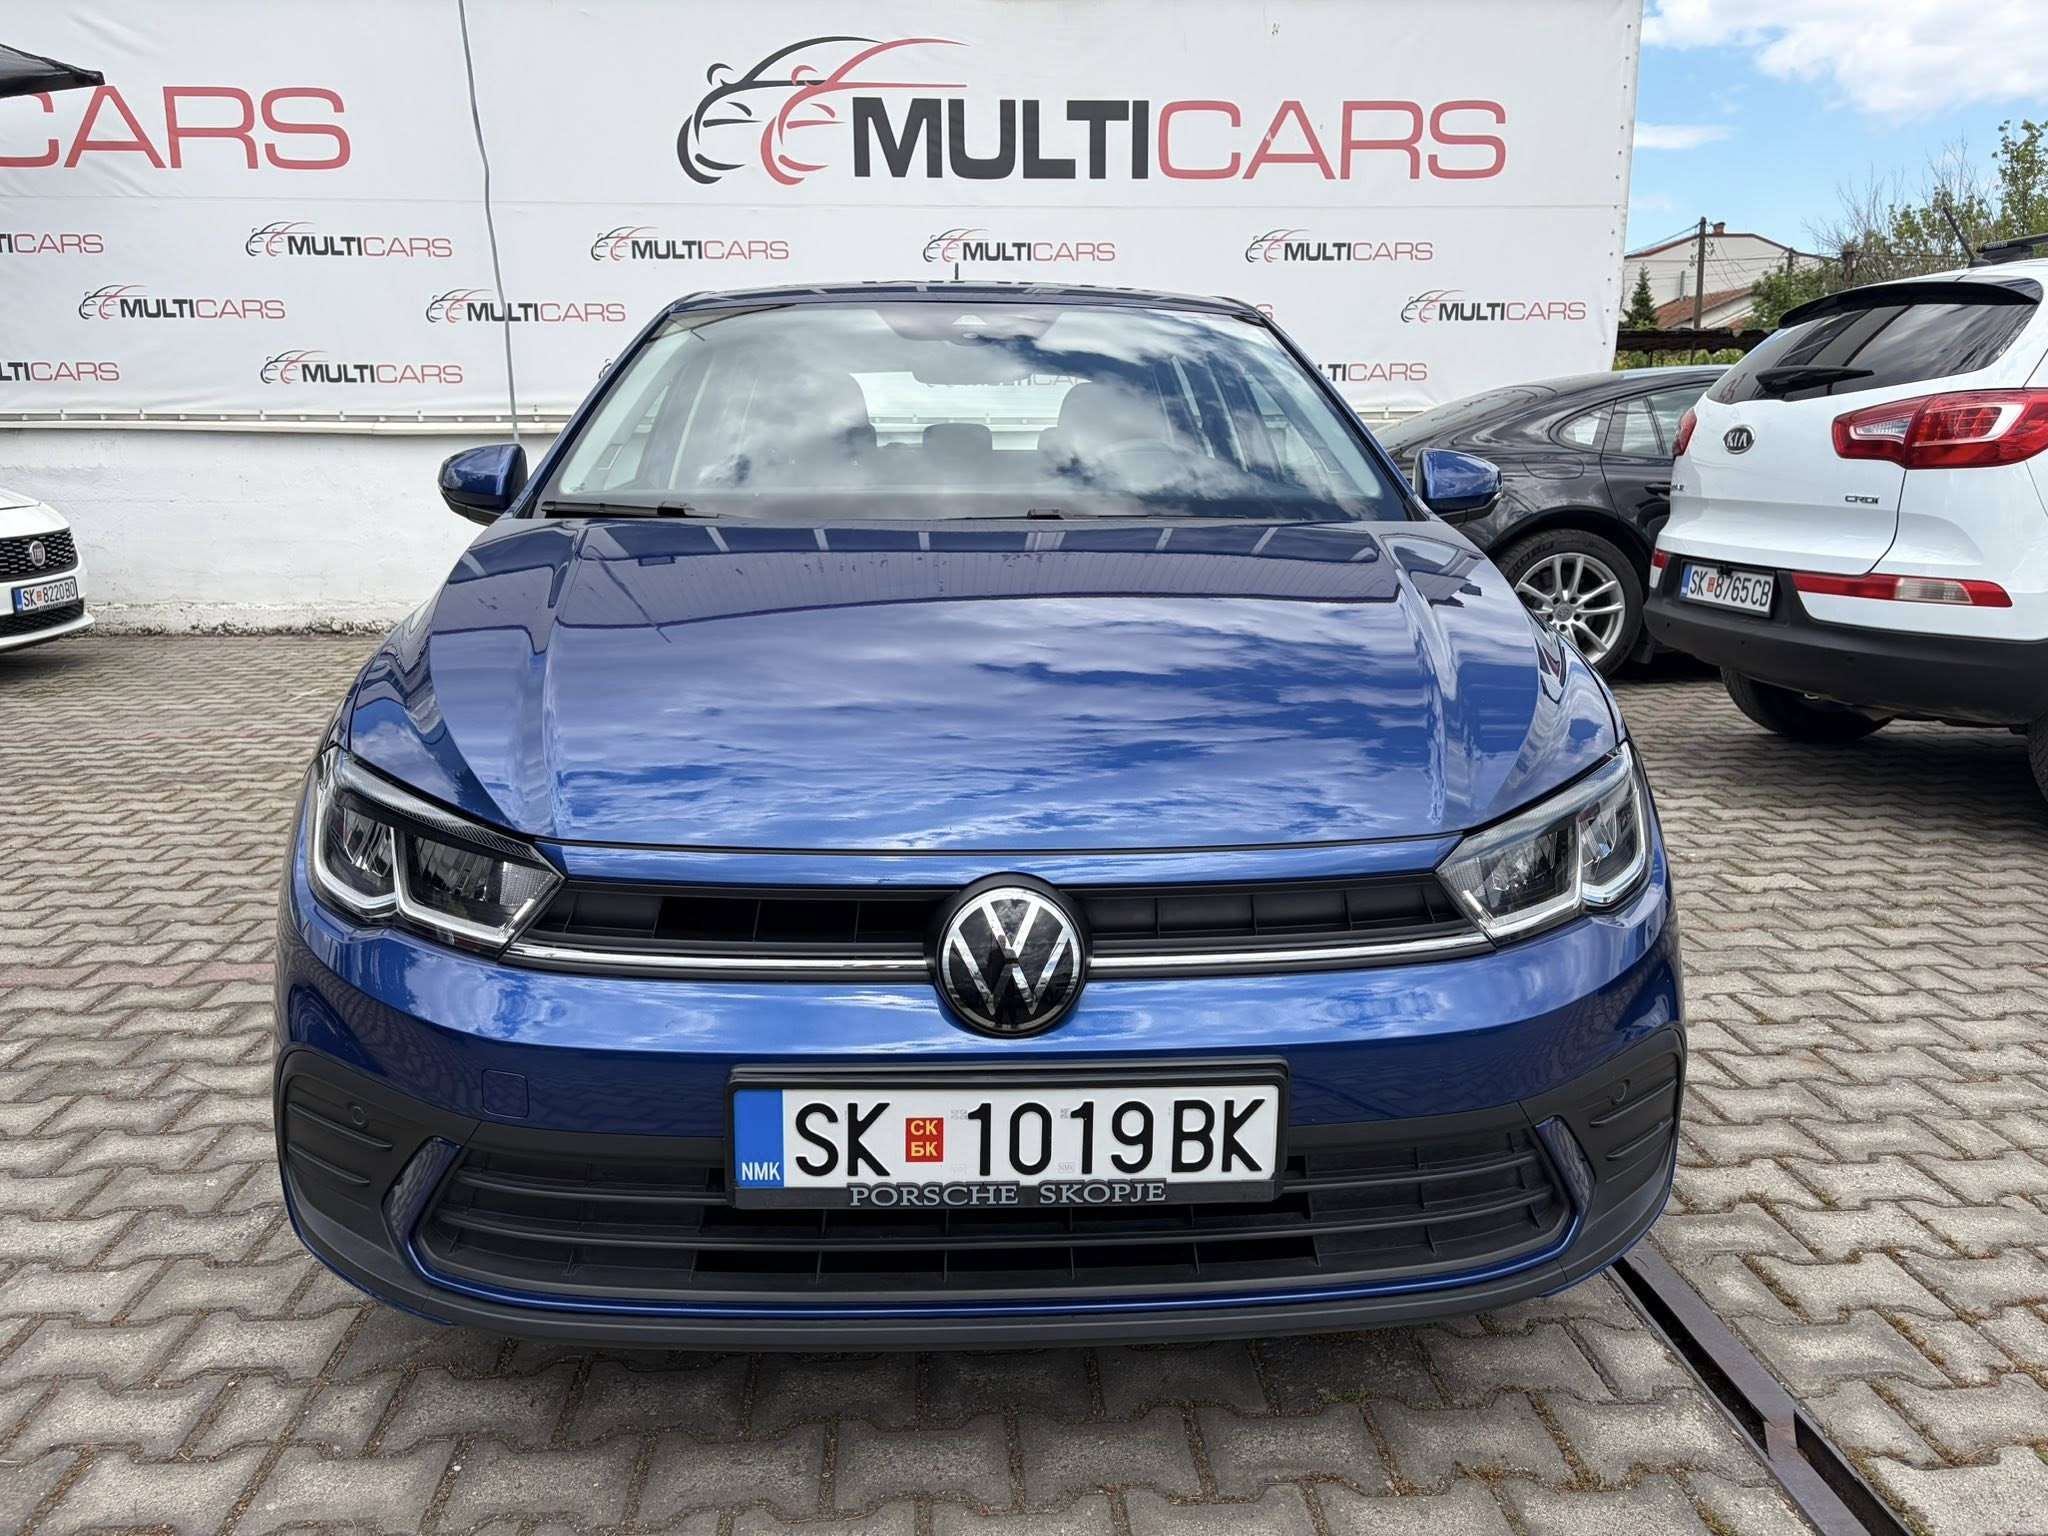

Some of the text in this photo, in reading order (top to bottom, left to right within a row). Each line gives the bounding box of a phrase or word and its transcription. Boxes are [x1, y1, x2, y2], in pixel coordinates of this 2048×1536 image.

[852, 96, 1506, 180] MULTICARS
[287, 235, 453, 258] MULTICARS
[631, 239, 789, 261] MULTICARS
[962, 241, 1116, 262] MULTICARS
[1283, 241, 1433, 262] MULTICARS
[119, 298, 286, 320] MULTICARS
[467, 302, 626, 322] MULTICARS
[1438, 301, 1586, 322] MULTICARS
[301, 363, 463, 384] MULTICARS
[1726, 431, 1748, 448] KIA
[1690, 570, 1707, 597] SK
[23, 589, 36, 607] SK
[795, 1102, 891, 1177] SK
[741, 1161, 781, 1181] NMK
[849, 1182, 1167, 1207] PORSCHE SKOPJE
